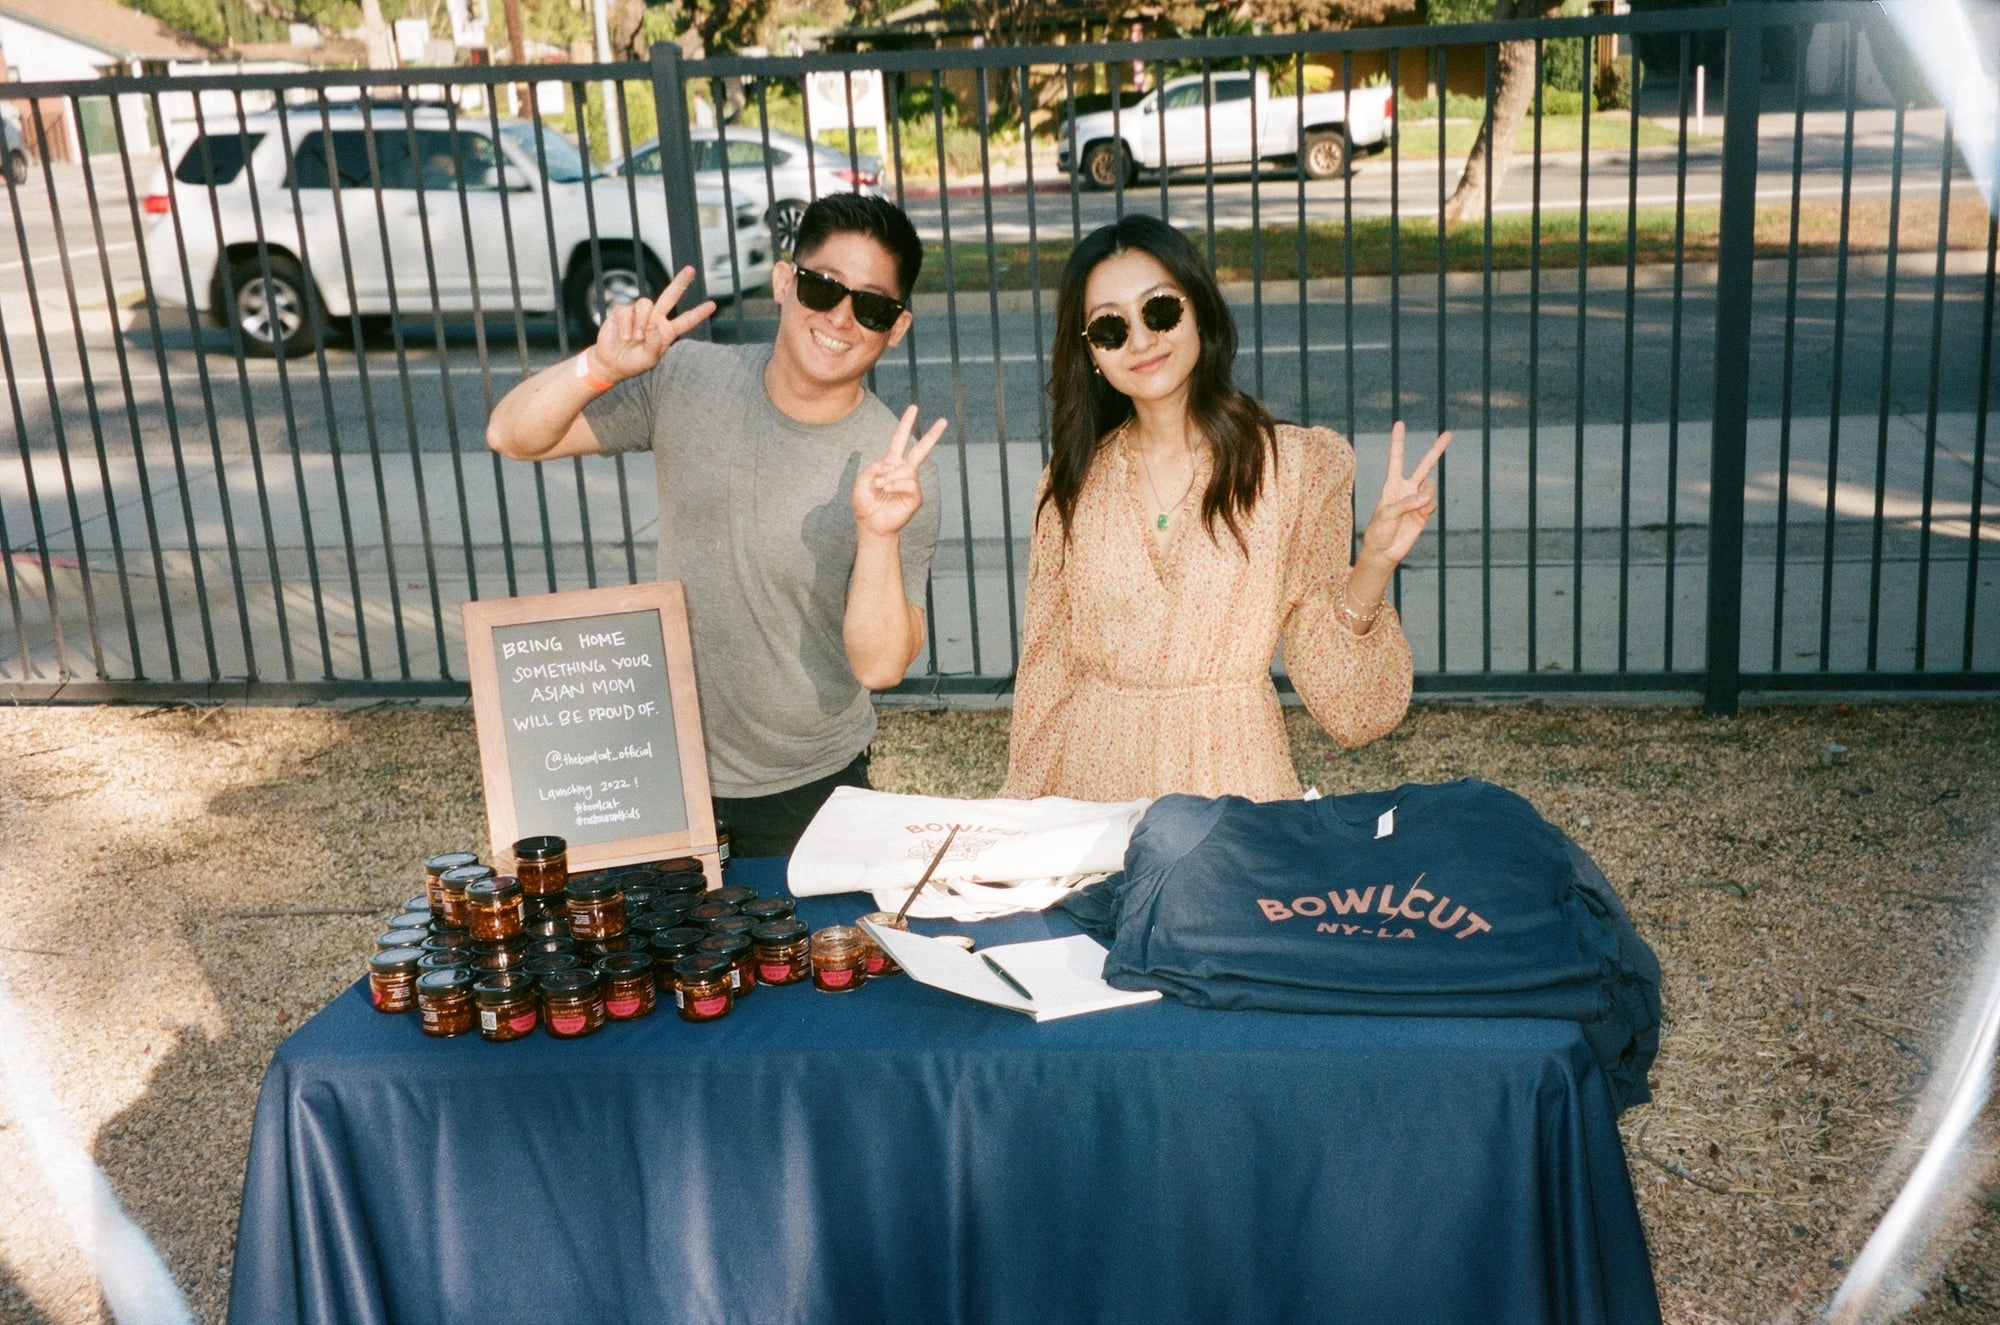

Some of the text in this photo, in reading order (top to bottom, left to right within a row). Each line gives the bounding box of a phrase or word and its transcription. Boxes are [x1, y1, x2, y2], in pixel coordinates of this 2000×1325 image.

[502, 631, 626, 659] BRING HOME
[512, 654, 652, 683] SOMETHING YOUR
[530, 678, 636, 703] ASIAN MOM
[513, 713, 553, 732] WILL
[558, 708, 584, 725] BE
[588, 704, 635, 722] PROUD
[539, 784, 593, 801] Launching
[573, 798, 621, 815] #bowlcut
[1256, 872, 1493, 940] BOWLCUT
[1316, 921, 1416, 939] NY-LA
